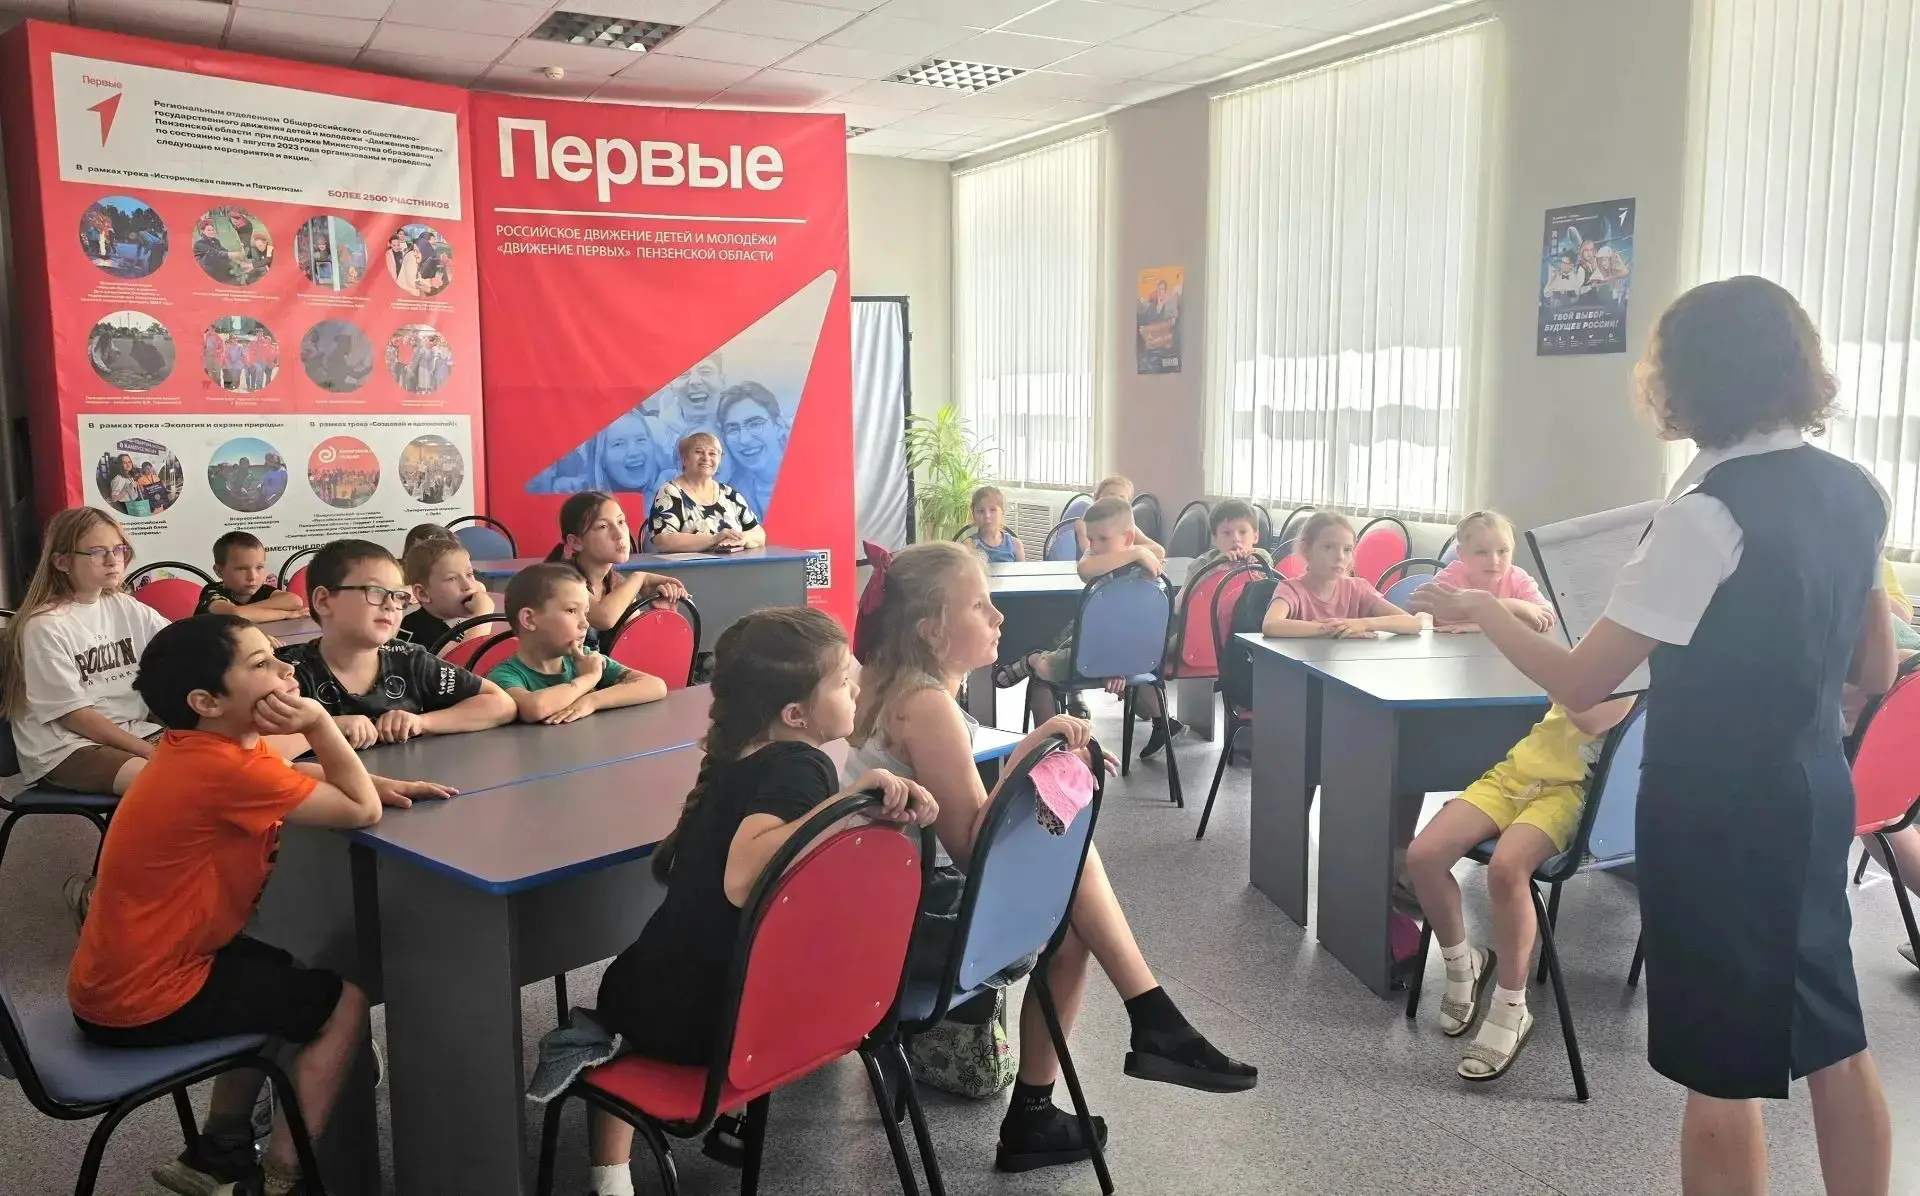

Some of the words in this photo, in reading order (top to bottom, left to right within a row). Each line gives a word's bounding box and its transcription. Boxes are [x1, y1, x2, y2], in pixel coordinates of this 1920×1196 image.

[82, 75, 122, 89] Первые
[154, 100, 225, 115] Региональным
[226, 110, 280, 123] отделением
[282, 117, 361, 134] Общероссийского
[154, 110, 239, 126] государственного
[240, 121, 285, 133] движения
[286, 127, 311, 136] детей
[319, 132, 363, 143] молодежи
[365, 137, 410, 149] «Движение
[155, 118, 213, 131] Пензенской
[214, 126, 252, 137] области
[254, 131, 272, 139] при
[273, 134, 321, 145] поддержке
[322, 138, 381, 153] Министерства
[156, 139, 213, 151] следующие
[214, 145, 275, 158] мероприятия
[283, 153, 312, 163] акции.
[169, 132, 221, 141] состоянию
[243, 139, 276, 149] августа
[277, 142, 299, 151] 2023
[321, 149, 380, 161] организованы
[497, 116, 784, 203] Первые
[88, 166, 121, 175] рамках
[123, 170, 149, 178] трека
[150, 172, 214, 184] «Историческая
[252, 182, 303, 193] Патриотизм»
[328, 189, 361, 200] БОЛЕЕ
[363, 193, 388, 202] 2500
[389, 196, 450, 209] УЧАСТНИКОВ
[496, 224, 582, 240] РОССИЙСКОЕ
[583, 229, 652, 243] ДВИЖЕНИЕ
[655, 230, 692, 244] ДЕТЕЙ
[695, 233, 704, 244] И
[706, 232, 777, 246] МОЛОДЁЖИ
[497, 242, 574, 257] «ДВИЖЕНИЕ
[576, 245, 631, 257] ПЕРВЫХ»
[637, 244, 716, 260] ПЕНЗЕНСКОЙ
[718, 249, 774, 262] ОБЛАСТИ
[1544, 322, 1581, 332] БУДУЩЕЕ
[1583, 320, 1619, 329] РОССИИ!
[1554, 311, 1574, 321] ТВОЙ
[1575, 311, 1604, 320] ВЫБОР
[134, 422, 160, 430] трека
[160, 421, 204, 429] «Экология
[264, 543, 310, 553] ВМЕСТНЫЕ
